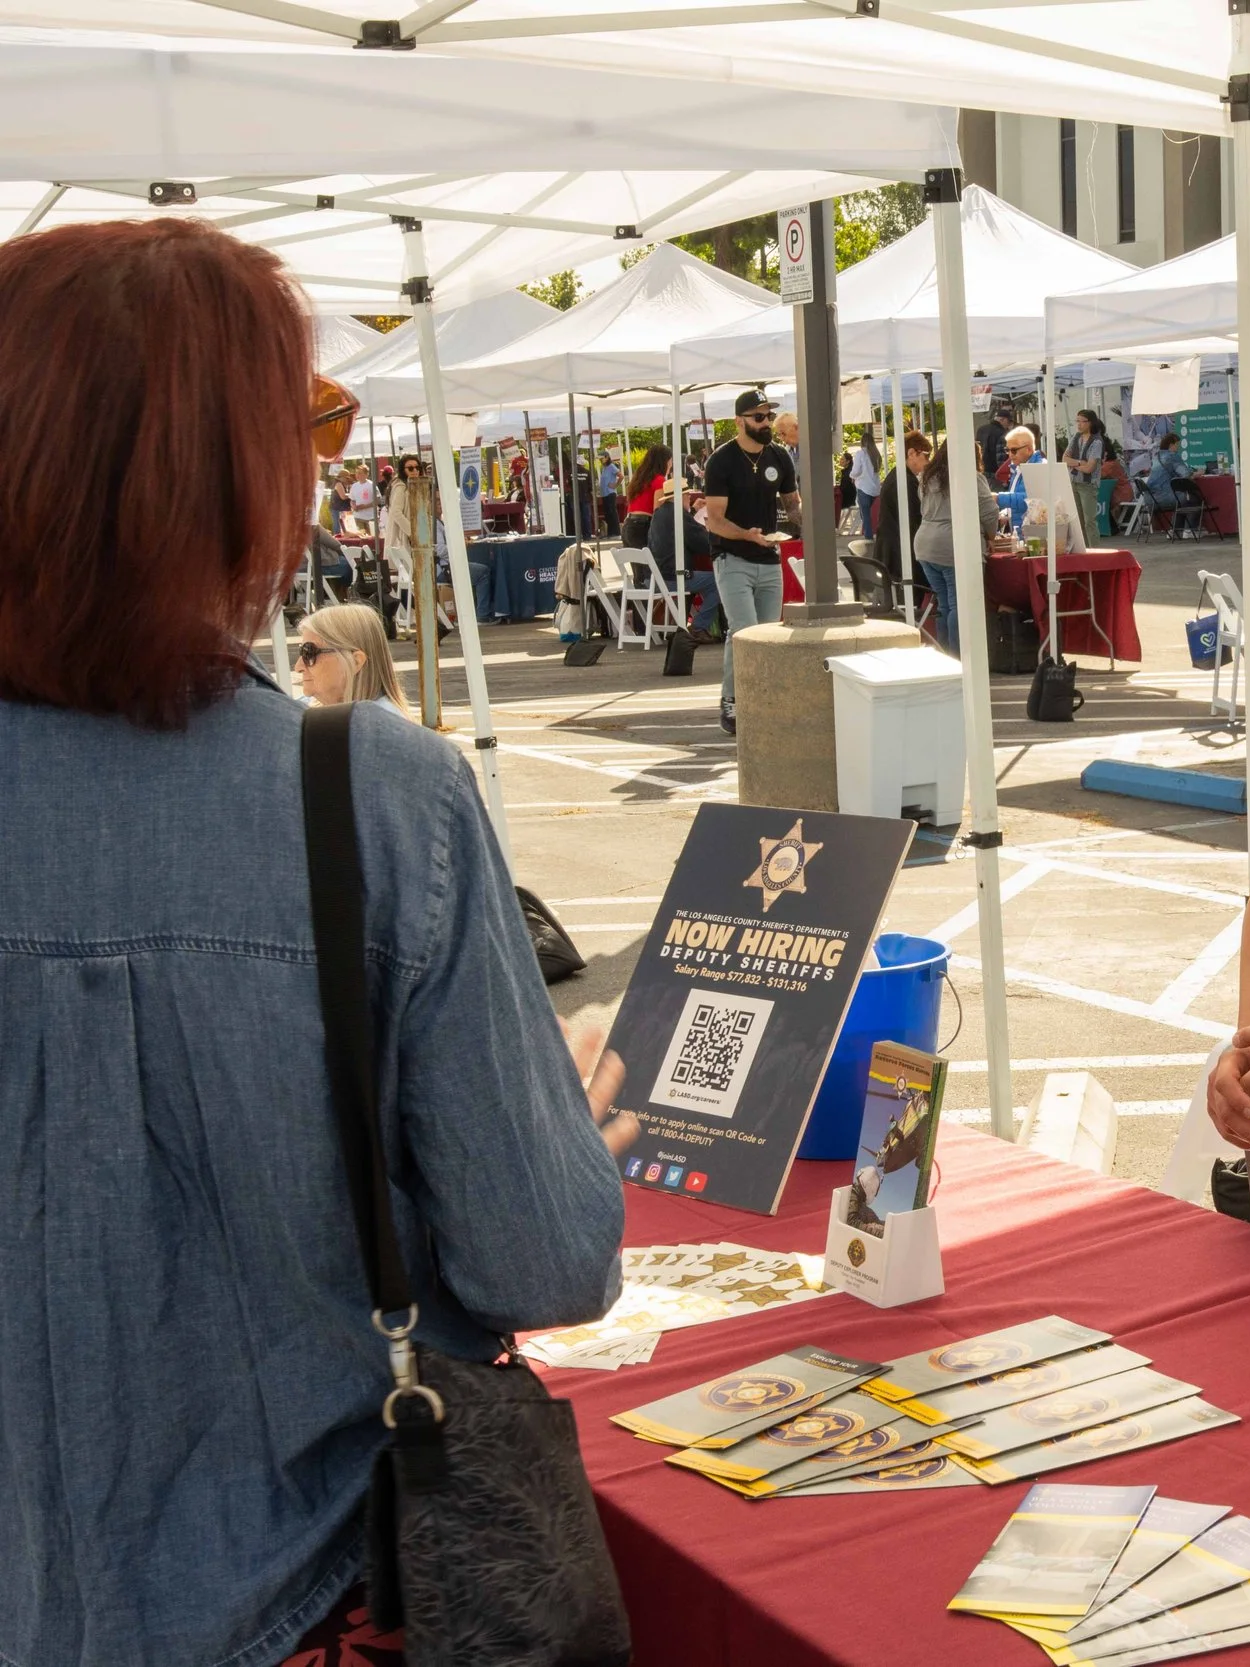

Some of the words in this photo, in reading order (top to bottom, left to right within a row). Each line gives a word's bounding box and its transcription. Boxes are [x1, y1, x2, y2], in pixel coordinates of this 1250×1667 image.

[780, 208, 797, 218] PARKING
[797, 205, 808, 215] ONLY
[790, 229, 799, 254] P
[676, 910, 688, 918] THE
[689, 912, 702, 920] LOS
[702, 913, 733, 924] ANGELES
[733, 917, 761, 927] COUNTY
[761, 921, 795, 931] SHERIFF'S
[795, 925, 841, 937] DEPARTMENT
[842, 931, 850, 939] IS
[664, 918, 736, 951] NOW
[736, 927, 846, 967] HIRING
[660, 945, 732, 966] DEPUTY
[740, 957, 835, 981] SHERIFFS
[674, 963, 699, 978] Salary
[700, 967, 726, 981] Range
[726, 970, 761, 985] $77,832
[766, 976, 808, 992] $131,316
[607, 1105, 619, 1115] For
[637, 1111, 650, 1121] info
[660, 1117, 667, 1125] to
[668, 1119, 687, 1131] apply
[688, 1122, 708, 1134] online
[709, 1128, 724, 1136] scan
[725, 1129, 738, 1139] QR
[738, 1132, 757, 1144] Code
[648, 1126, 660, 1135] call
[661, 1129, 715, 1147] 1800-A-DEPUTY
[657, 1150, 686, 1163] @joinLASD
[810, 1353, 840, 1365] EXPLORE
[839, 1361, 859, 1369] YOUR
